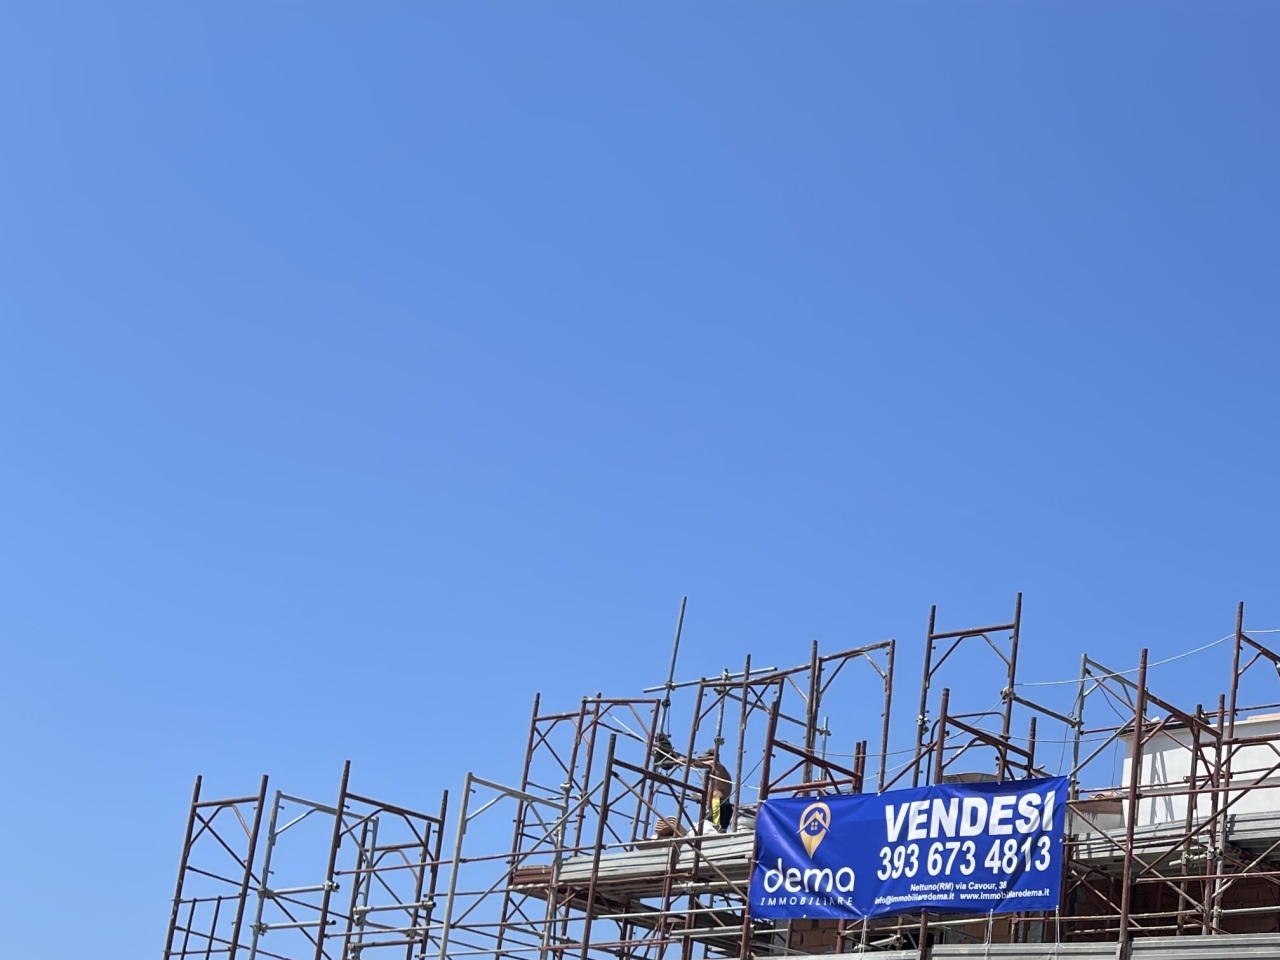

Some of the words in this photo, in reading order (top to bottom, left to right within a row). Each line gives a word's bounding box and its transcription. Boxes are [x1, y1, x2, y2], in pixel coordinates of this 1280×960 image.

[885, 790, 1056, 843] VENDESI
[763, 857, 856, 894] dema
[877, 843, 920, 881] 393
[927, 840, 976, 876] 673
[984, 835, 1051, 874] 4813
[760, 896, 853, 906] IMMOBILIARE
[910, 882, 954, 892] Nettuno(RM)
[955, 882, 967, 890] via
[968, 881, 997, 890] Cavour,
